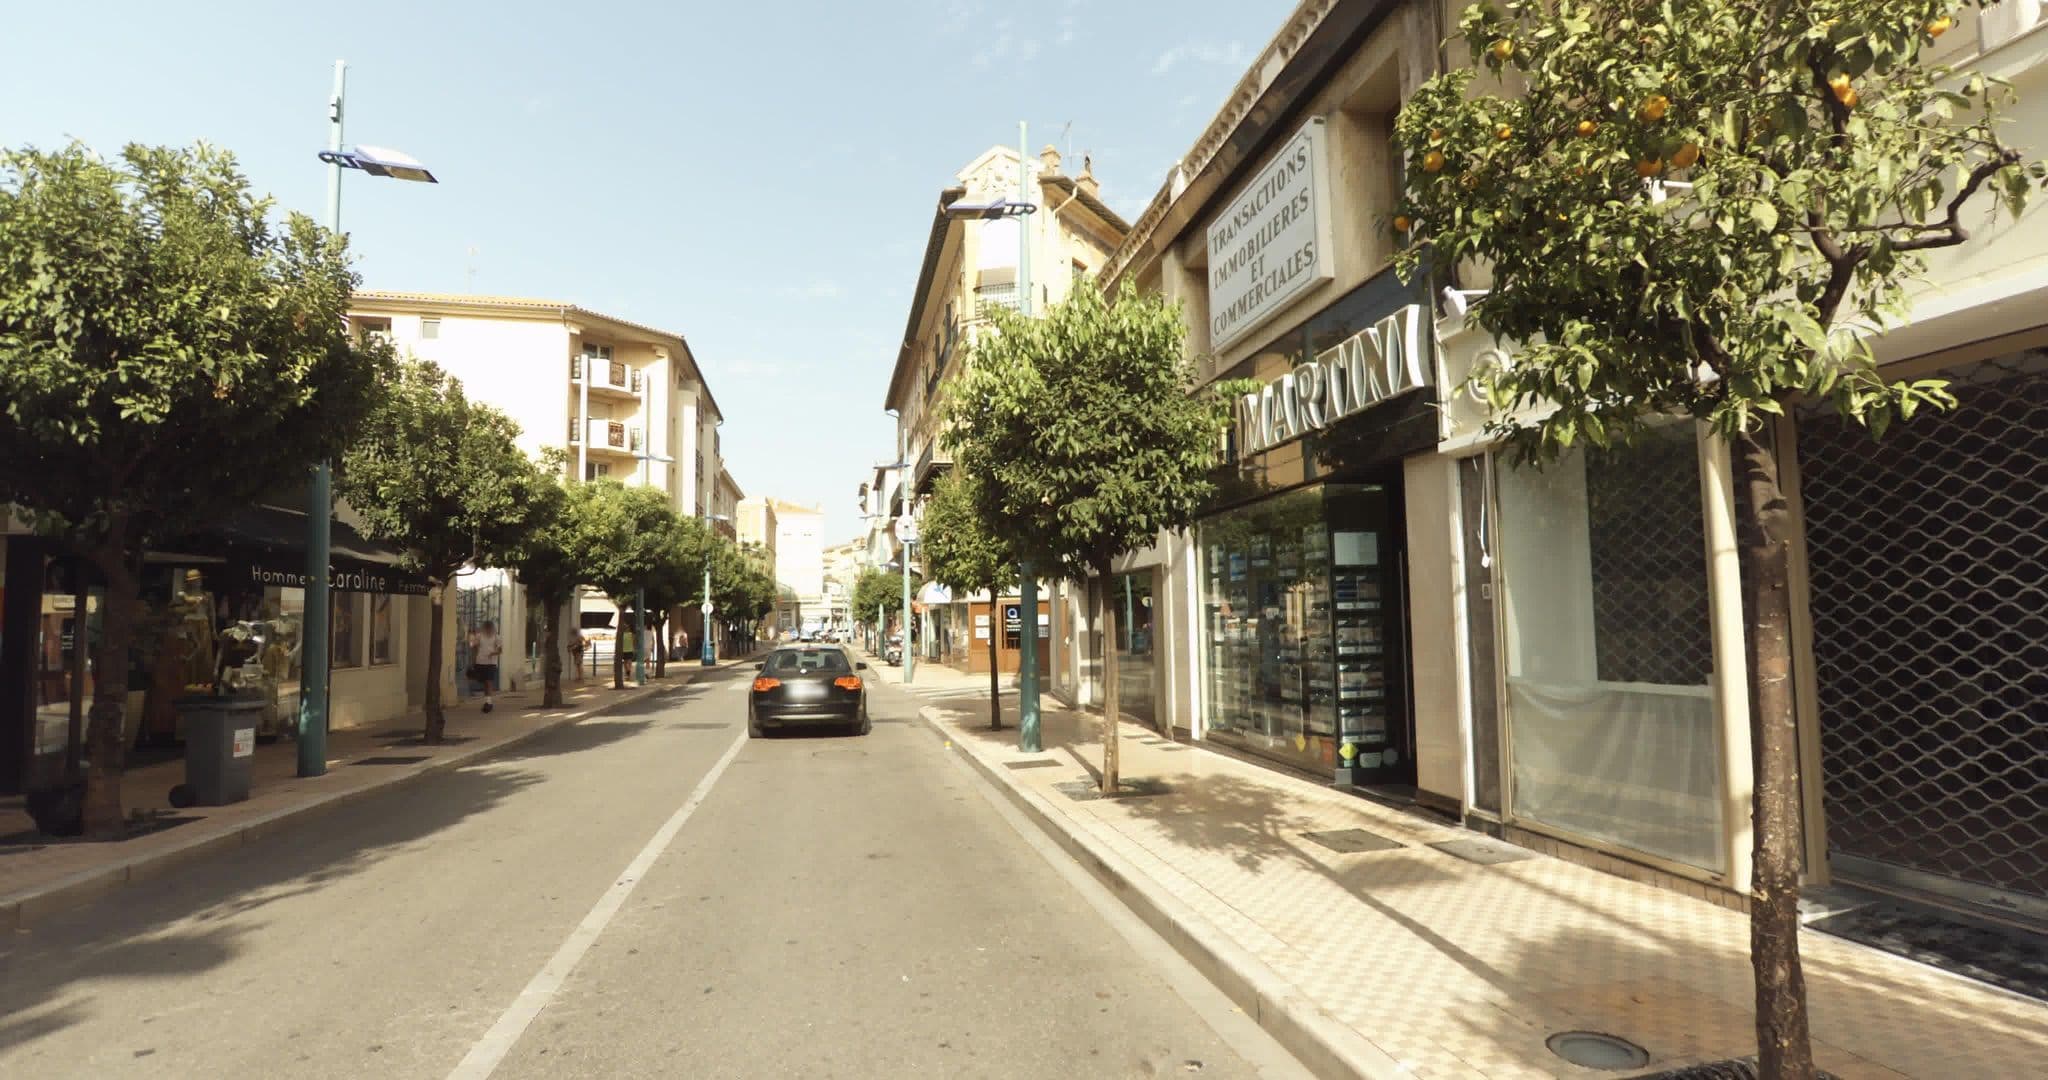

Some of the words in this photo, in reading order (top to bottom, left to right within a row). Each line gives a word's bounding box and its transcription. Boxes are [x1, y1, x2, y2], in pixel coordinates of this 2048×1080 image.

[1212, 146, 1306, 256] TRANSACTIONS
[1214, 187, 1308, 290] IMMOBILIERES
[1213, 241, 1314, 336] COMMERCIALES
[1251, 254, 1265, 284] ET
[1242, 304, 1425, 456] MARTINI
[252, 565, 305, 585] Homme
